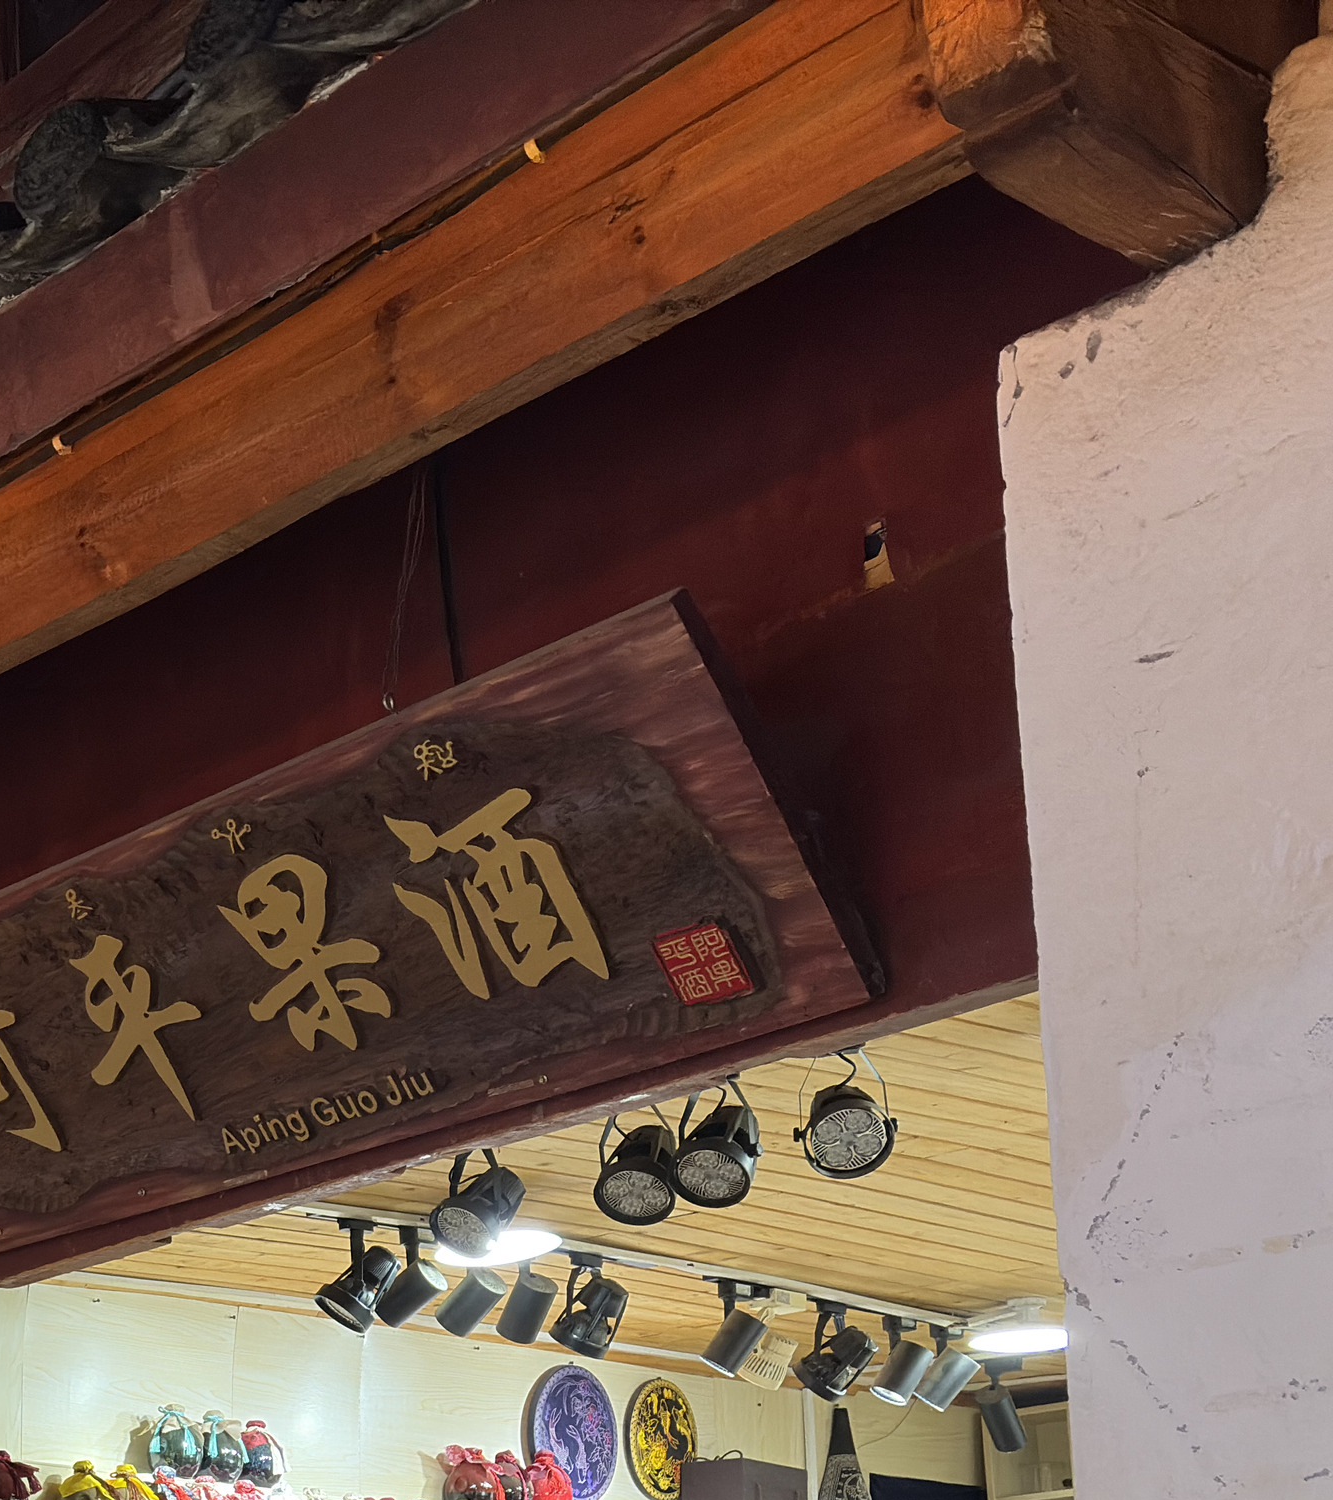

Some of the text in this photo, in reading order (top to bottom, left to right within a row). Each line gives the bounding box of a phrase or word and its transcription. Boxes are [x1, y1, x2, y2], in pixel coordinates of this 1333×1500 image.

[221, 1071, 435, 1154] Aping Guo Jiu
